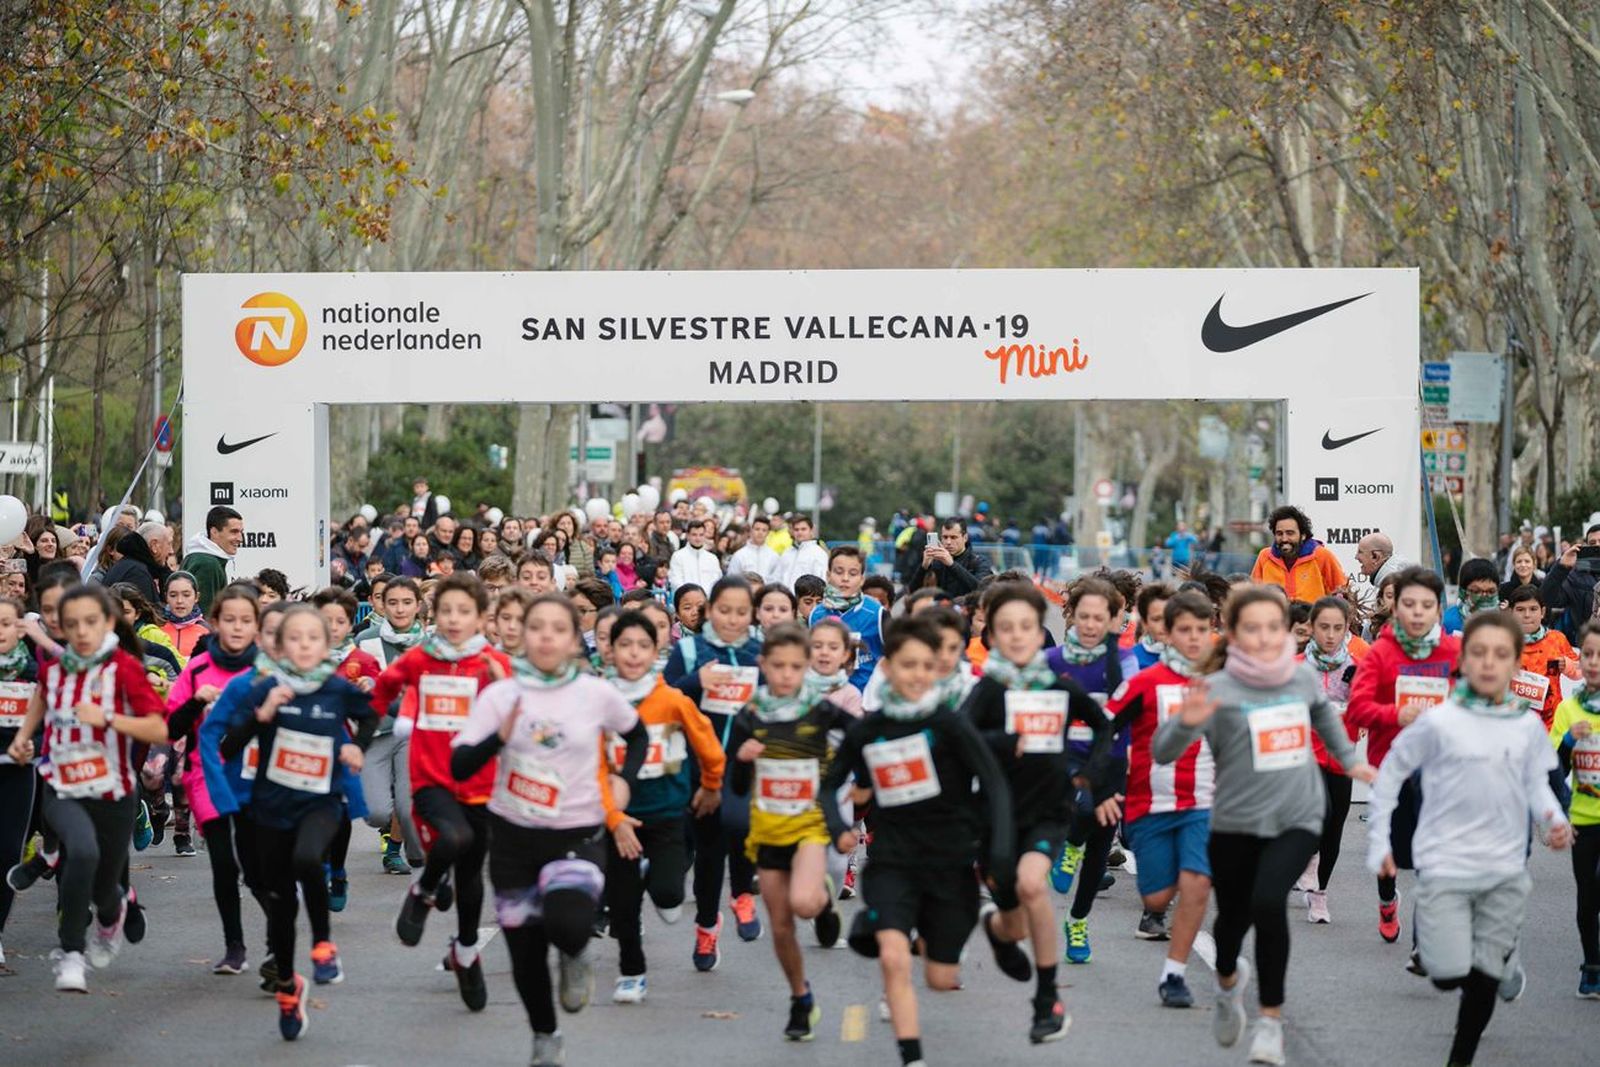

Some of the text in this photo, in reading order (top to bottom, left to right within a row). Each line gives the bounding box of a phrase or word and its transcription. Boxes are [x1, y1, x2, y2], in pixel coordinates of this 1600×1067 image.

[322, 301, 440, 324] nationale
[322, 328, 482, 351] nederlanden
[521, 317, 585, 341] SAN
[598, 316, 771, 341] SILVESTRE
[709, 360, 838, 385] MADRID
[984, 338, 1088, 384] mini
[239, 488, 288, 499] xiaomi
[1344, 484, 1394, 495] xiaomi
[1513, 683, 1539, 698] 1398
